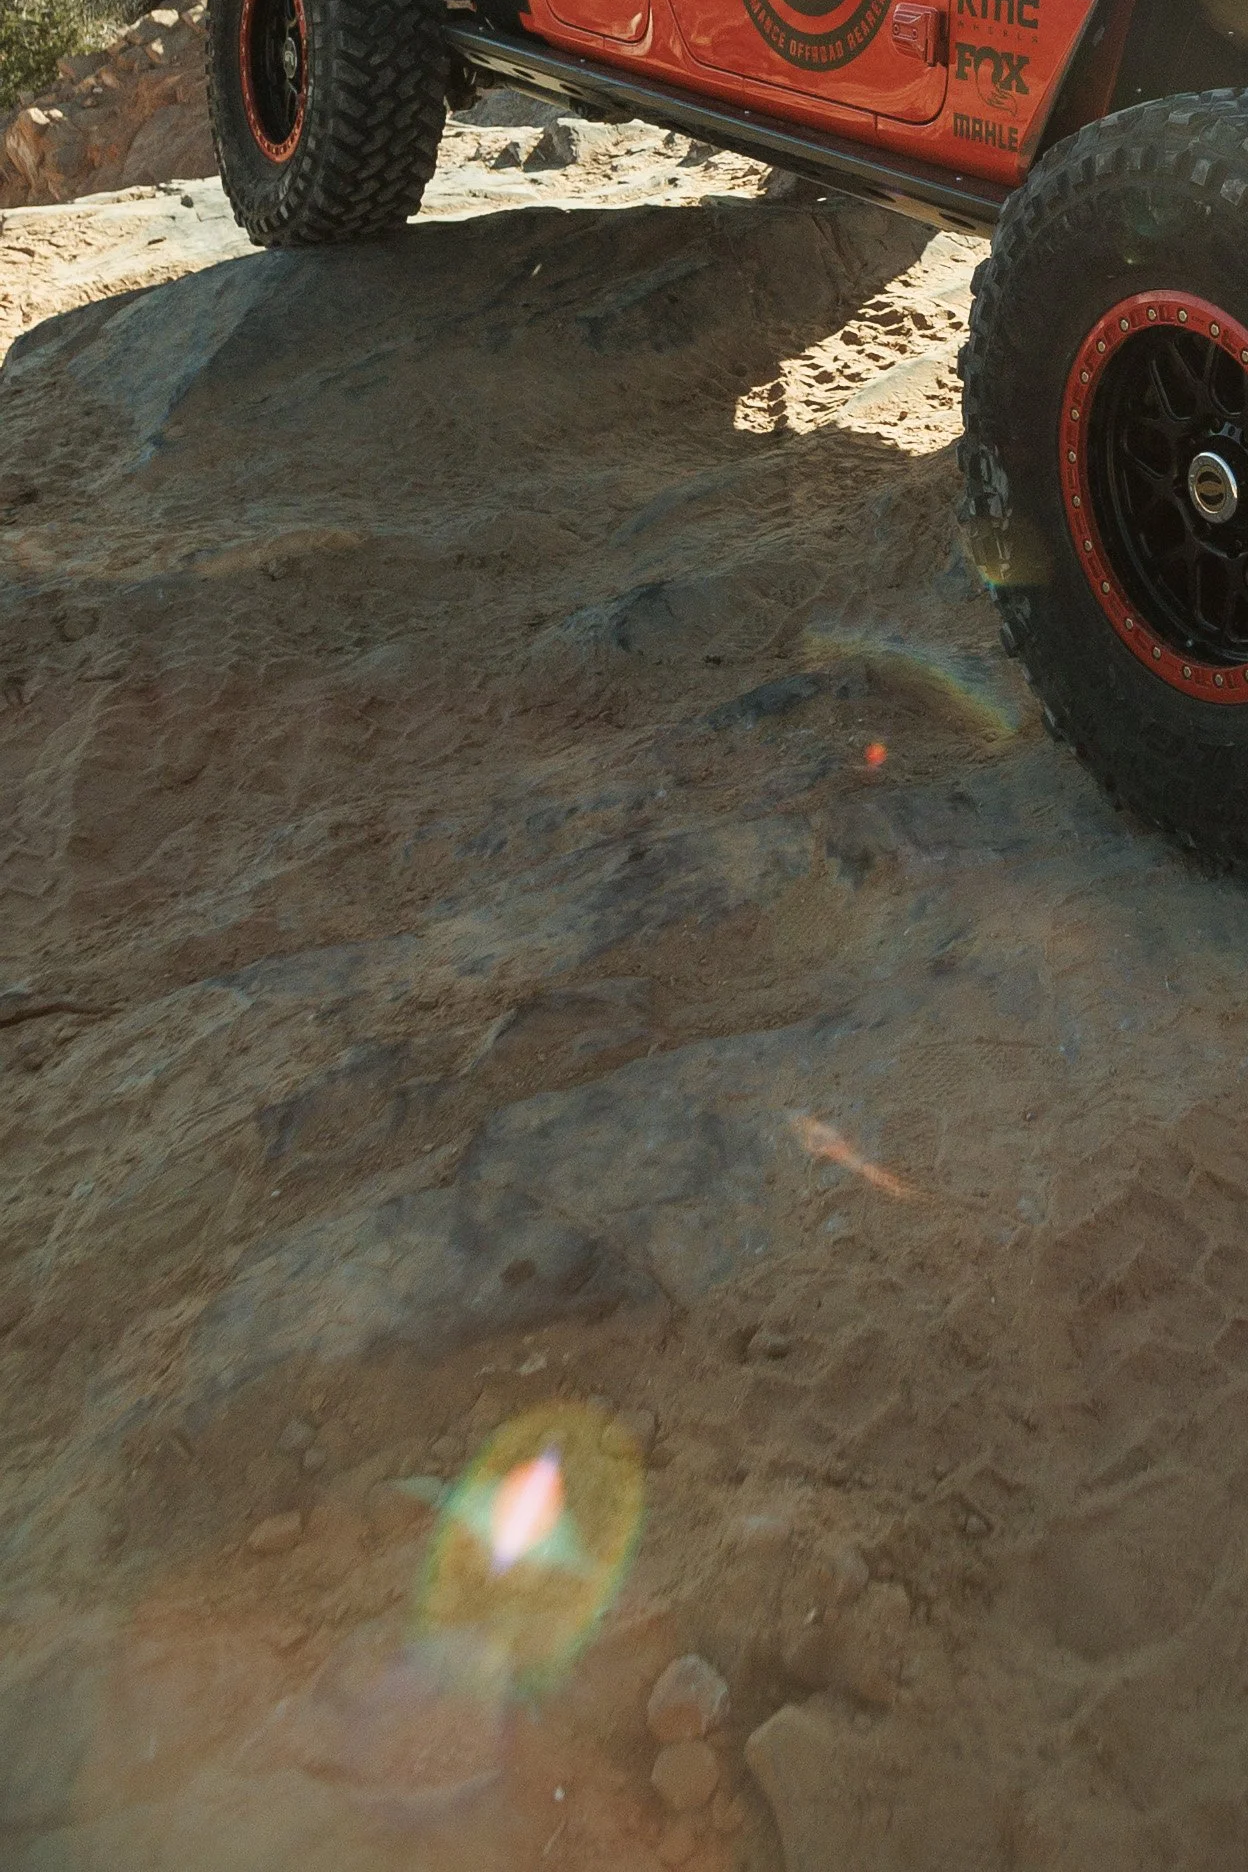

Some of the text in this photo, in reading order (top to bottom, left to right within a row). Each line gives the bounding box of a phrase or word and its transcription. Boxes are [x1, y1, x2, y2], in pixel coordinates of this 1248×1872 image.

[789, 39, 844, 64] OFFROAD
[955, 41, 1031, 96] FOX
[953, 112, 1019, 153] MAHLE
